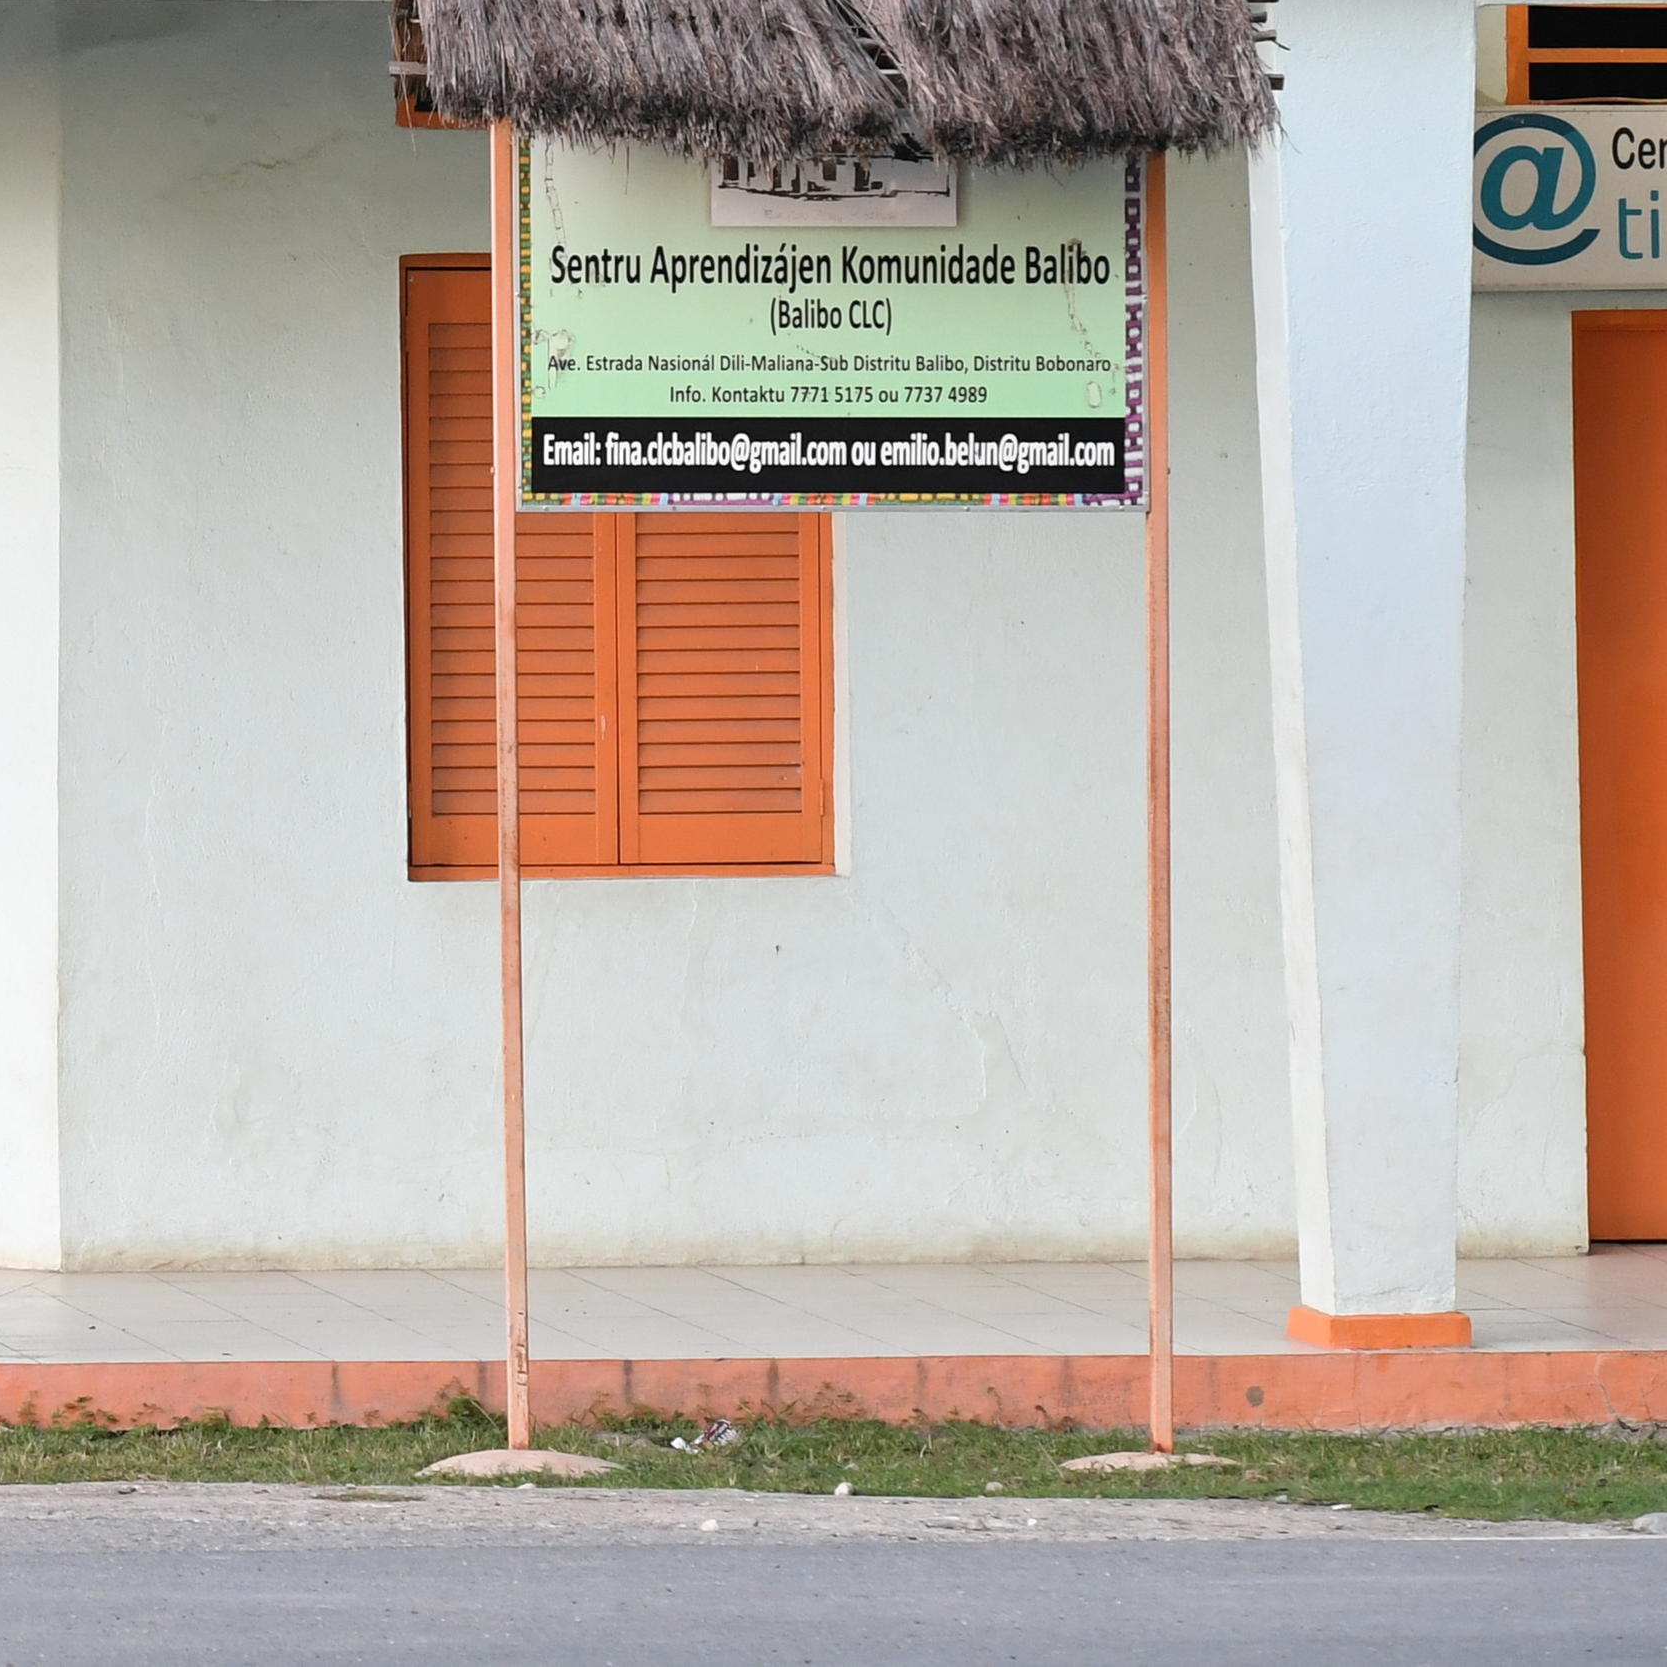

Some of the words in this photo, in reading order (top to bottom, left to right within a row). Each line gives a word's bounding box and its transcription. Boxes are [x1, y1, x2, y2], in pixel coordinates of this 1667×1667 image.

[550, 245, 641, 284] Sentru
[649, 242, 832, 294] Aprendizájen
[841, 243, 1016, 285] Komunidade
[1025, 243, 1110, 285] Balibo
[770, 297, 842, 336] (Balibo
[848, 297, 892, 336] CLC)
[547, 355, 581, 372] Ave.
[586, 355, 643, 372] Estrada
[648, 354, 715, 372] Nasionál
[720, 354, 849, 372] Dili-Maliana-Sub
[854, 355, 911, 372] Distritu
[916, 355, 969, 375] Balibo,
[973, 355, 1031, 372] Distritu
[1036, 355, 1112, 372] Bobonaro
[670, 386, 707, 404] Info.
[712, 386, 785, 404] Kontaktu
[791, 386, 829, 404] 7771
[835, 386, 874, 404] 5175
[878, 390, 899, 404] ou
[904, 386, 943, 404] 7737
[948, 386, 988, 404] 4989
[543, 431, 602, 466] Email:
[605, 431, 848, 473] fina.clcbalibo@gmail.com
[851, 441, 877, 466] ou
[880, 432, 1115, 474] emilio.belun@gmail.com
